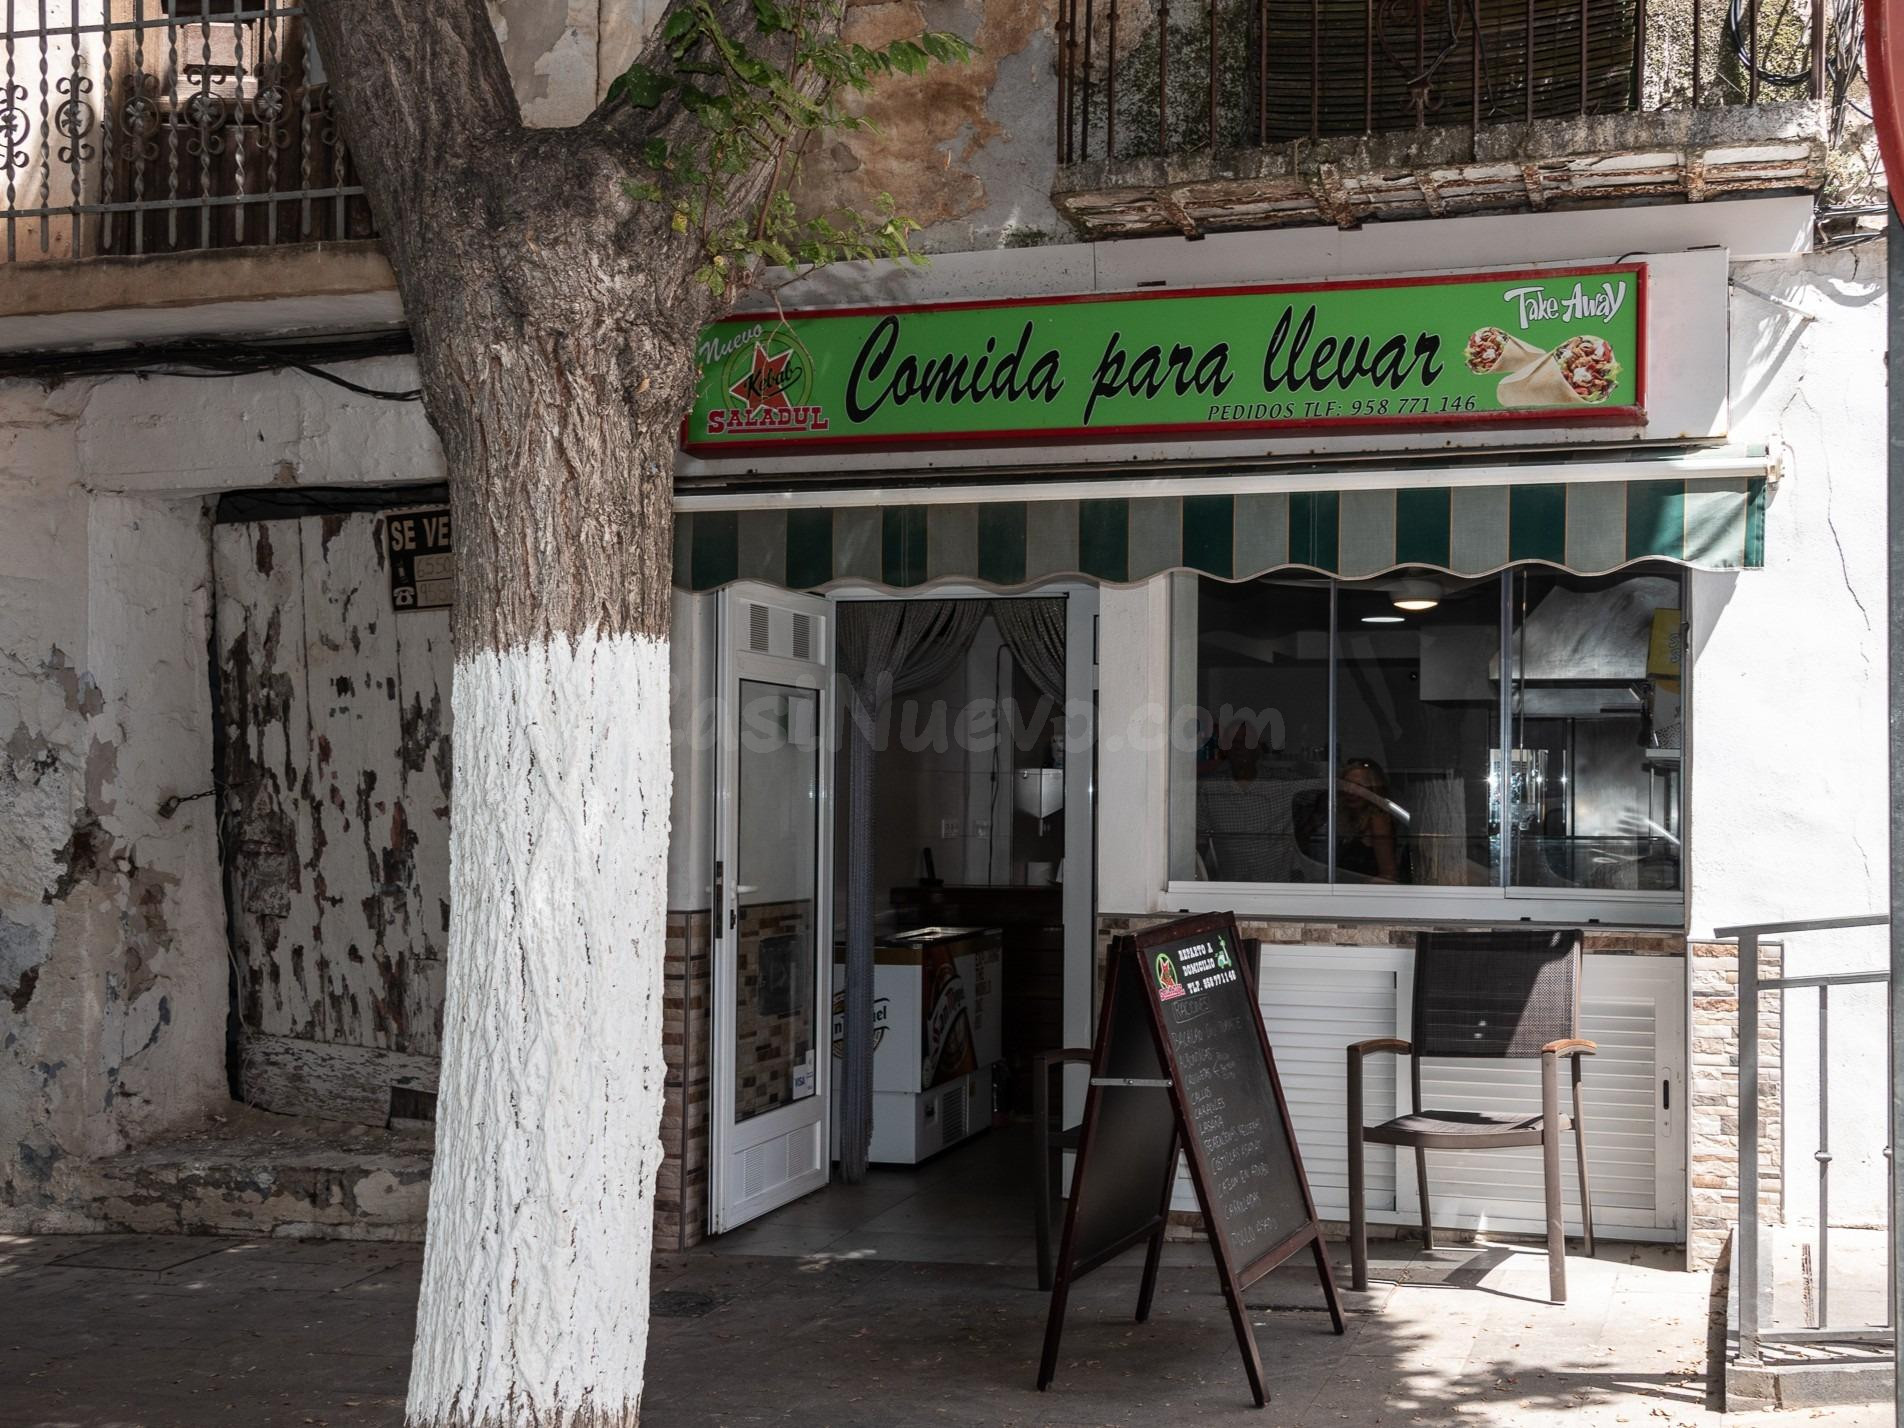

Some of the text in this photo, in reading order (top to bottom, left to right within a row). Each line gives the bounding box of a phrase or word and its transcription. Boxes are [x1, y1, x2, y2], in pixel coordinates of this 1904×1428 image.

[1504, 280, 1627, 330] Take Away
[699, 324, 762, 365] Nuevo
[845, 303, 1445, 427] Comida para llevar
[706, 406, 829, 434] SALADUL
[1207, 394, 1477, 421] PEDIDOS TLF: 958 771 146
[391, 519, 417, 552] SE
[1177, 942, 1214, 962] REPARTO A
[1182, 957, 1216, 977] DOMICILIO
